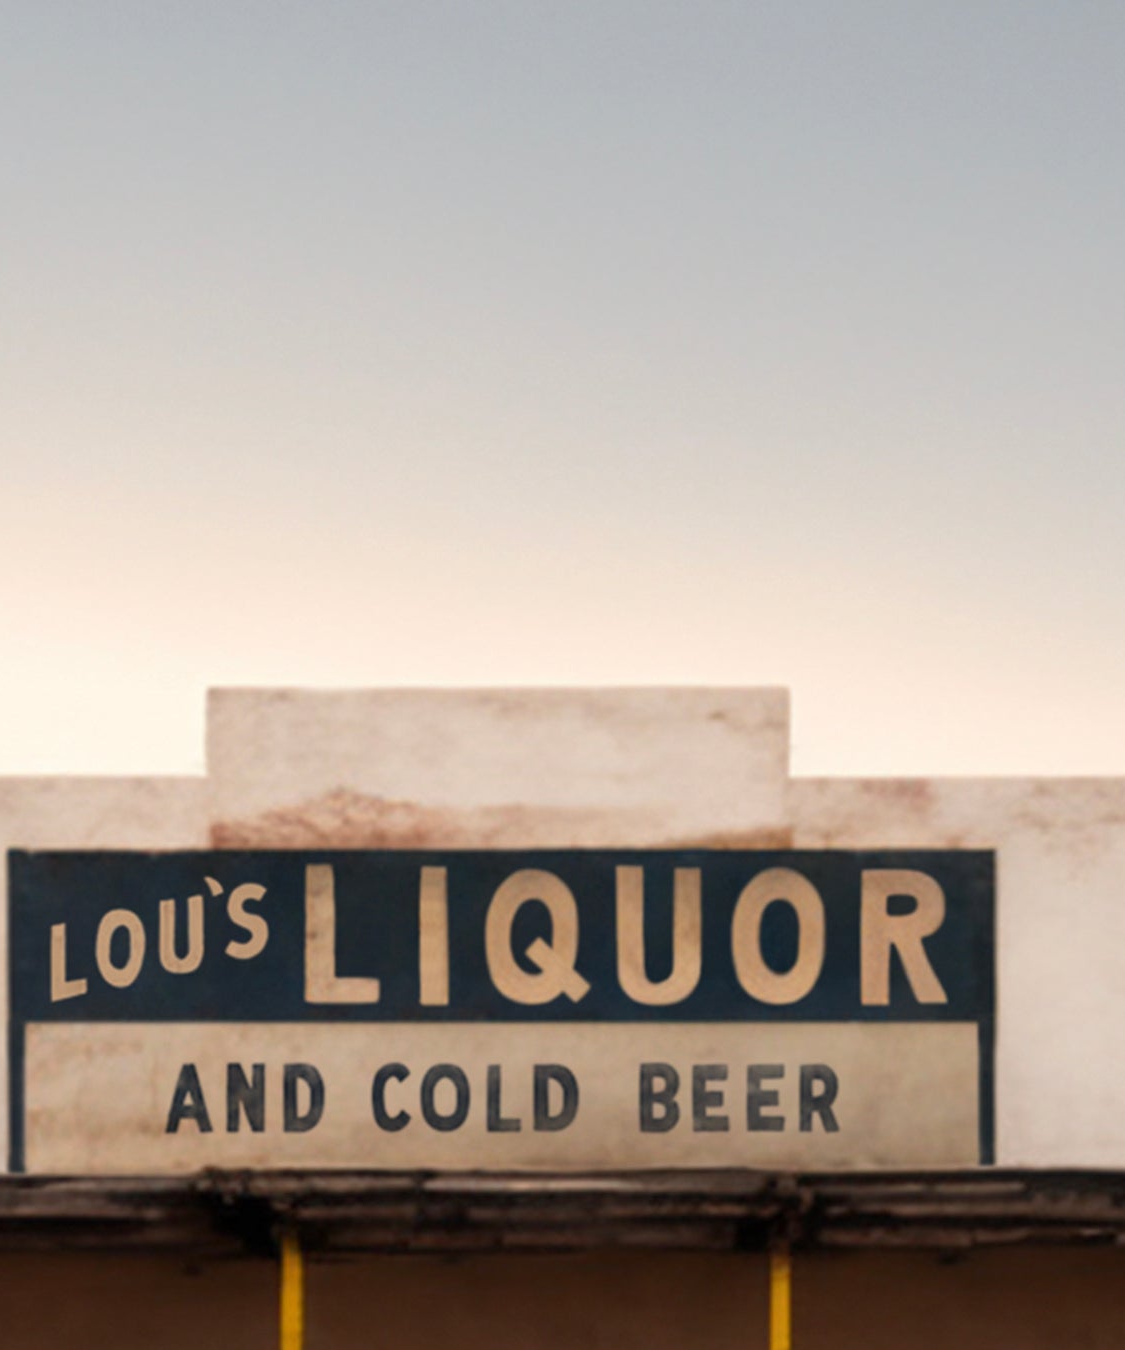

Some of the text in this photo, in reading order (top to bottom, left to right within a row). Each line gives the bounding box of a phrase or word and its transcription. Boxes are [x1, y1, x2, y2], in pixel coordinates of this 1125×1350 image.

[49, 862, 950, 1007] LOU'S LIQUOR
[164, 1062, 841, 1134] AND COLD BEER
